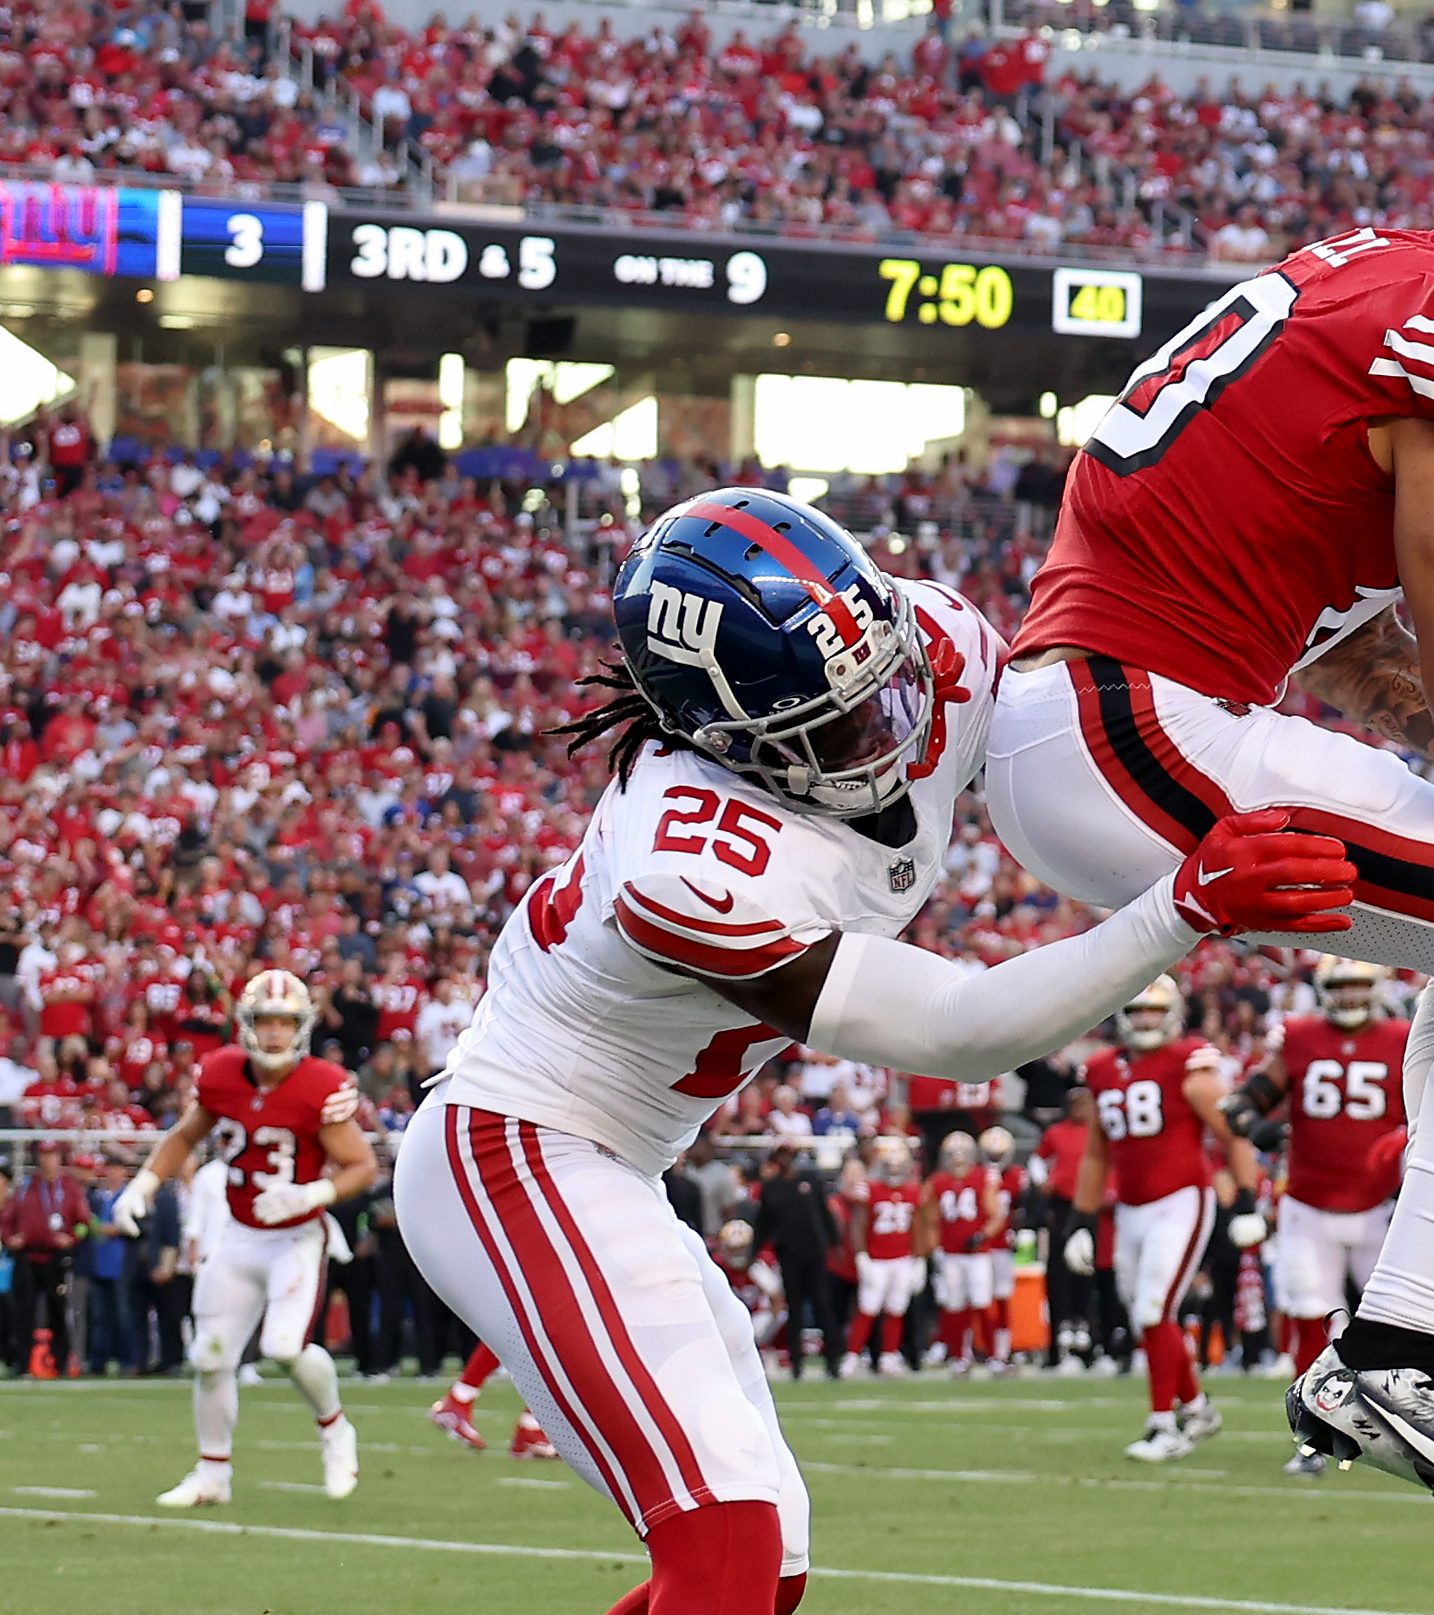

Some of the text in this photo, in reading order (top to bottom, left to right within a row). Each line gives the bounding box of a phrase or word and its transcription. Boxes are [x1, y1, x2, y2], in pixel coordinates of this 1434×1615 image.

[225, 213, 264, 268] 3
[351, 224, 767, 304] 3RD & 5 ON THE 9
[879, 259, 1014, 329] 7:50
[1071, 285, 1125, 321] 40
[807, 585, 874, 660] 25
[652, 785, 783, 878] 25
[1097, 1080, 1163, 1140] 68
[1303, 1059, 1388, 1120] 65
[211, 1117, 296, 1187] 23
